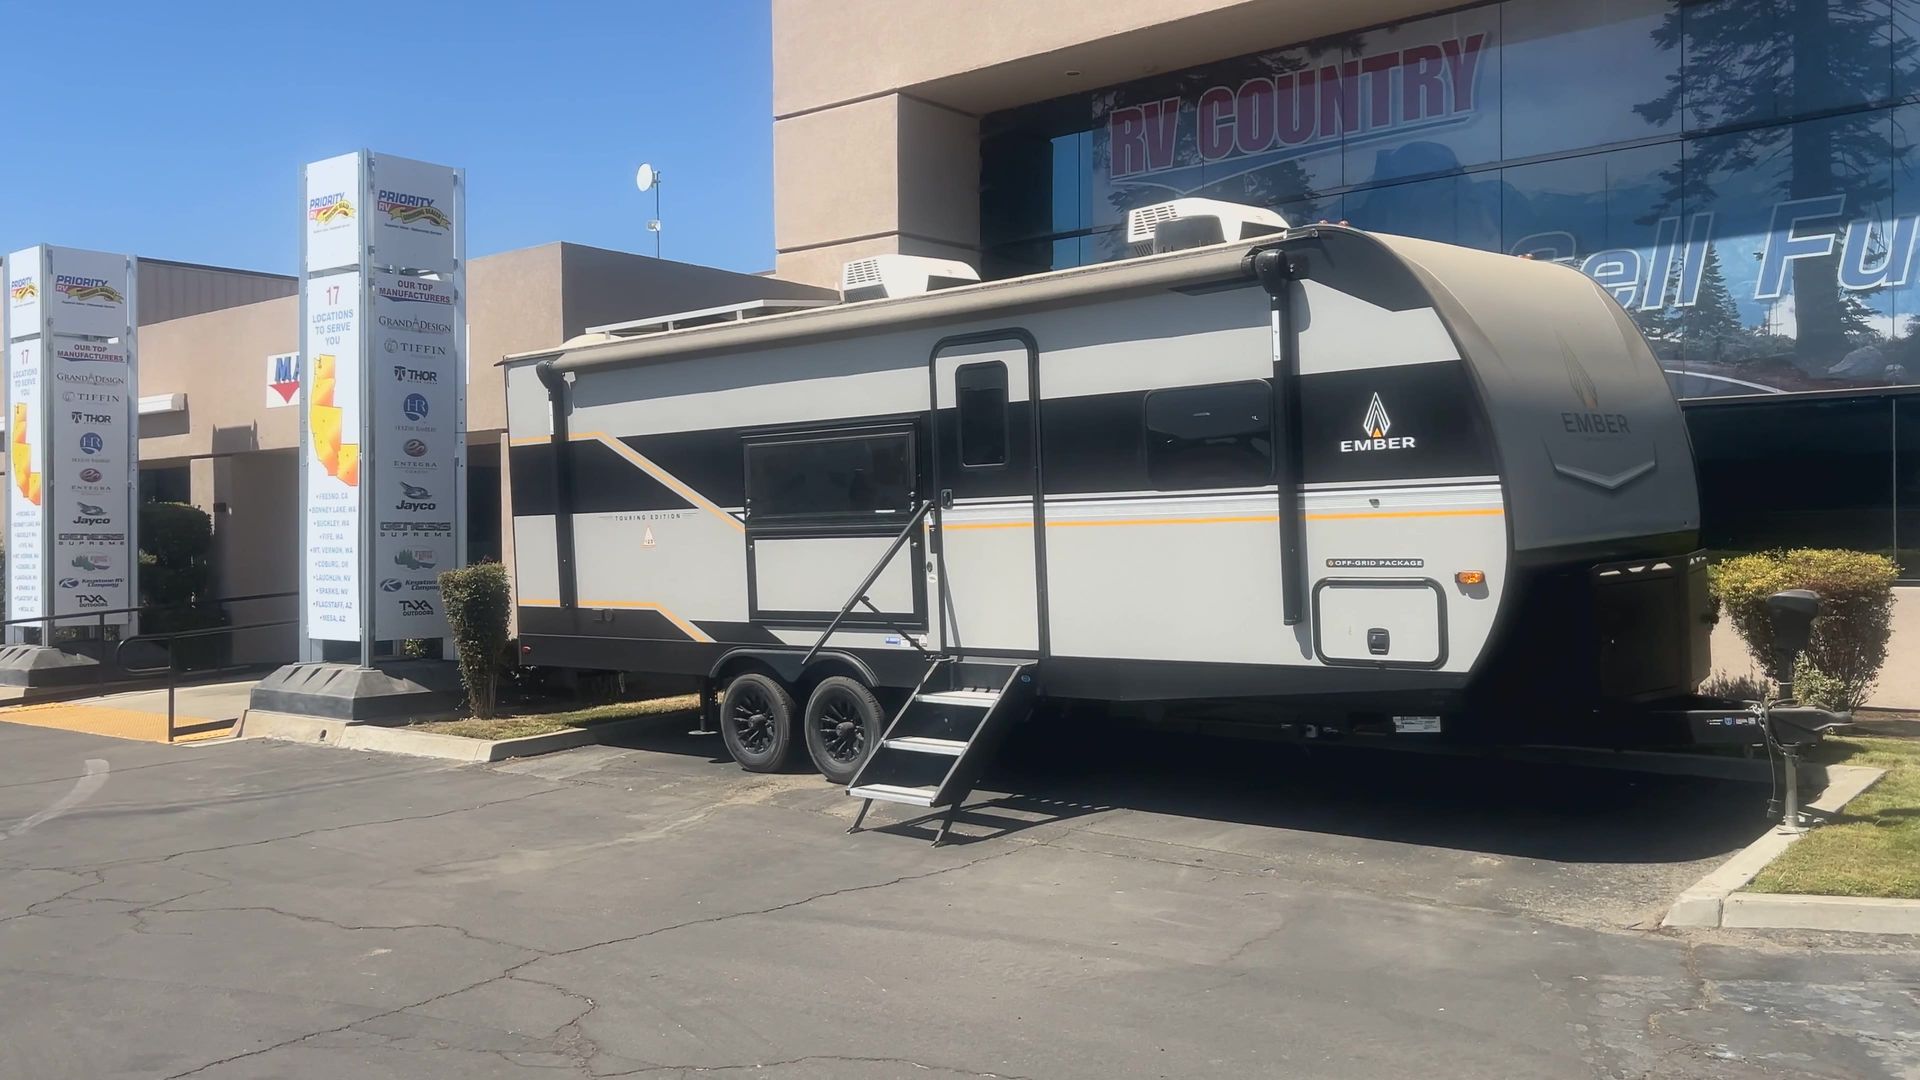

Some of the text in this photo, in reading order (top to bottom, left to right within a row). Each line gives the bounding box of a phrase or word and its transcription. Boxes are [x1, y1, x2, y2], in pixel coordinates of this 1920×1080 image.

[1108, 30, 1488, 179] RV COUNTRY
[309, 192, 345, 209] PRIORITY
[378, 189, 435, 207] PRIORITY
[378, 202, 391, 212] RV
[56, 274, 108, 287] PRIORITY
[397, 280, 434, 292] OUR TOP
[56, 284, 68, 292] RV
[326, 286, 340, 306] 17
[379, 287, 450, 303] MANUFACTURERS
[312, 309, 354, 323] LOCATIONS
[315, 322, 351, 336] TO SERVE
[378, 315, 413, 328] GRAND
[420, 320, 452, 333] DESIGN
[325, 336, 341, 346] YOU
[57, 350, 124, 362] MANUFACTURERS
[401, 343, 447, 356] TIFFIN
[21, 349, 29, 365] 17
[56, 372, 89, 383] GRAND
[95, 375, 124, 385] DESIGN
[407, 369, 438, 382] THOR
[77, 393, 120, 402] TIFFIN
[84, 413, 112, 423] THOR
[1560, 412, 1632, 434] EMBER
[1340, 436, 1416, 453] EMBER
[393, 459, 438, 468] ENTEGRA
[395, 499, 437, 512] Jayco
[73, 516, 111, 526] Jayco
[380, 521, 452, 532] GENESIS
[75, 594, 106, 604] TAXA
[398, 600, 433, 611] TAXA
